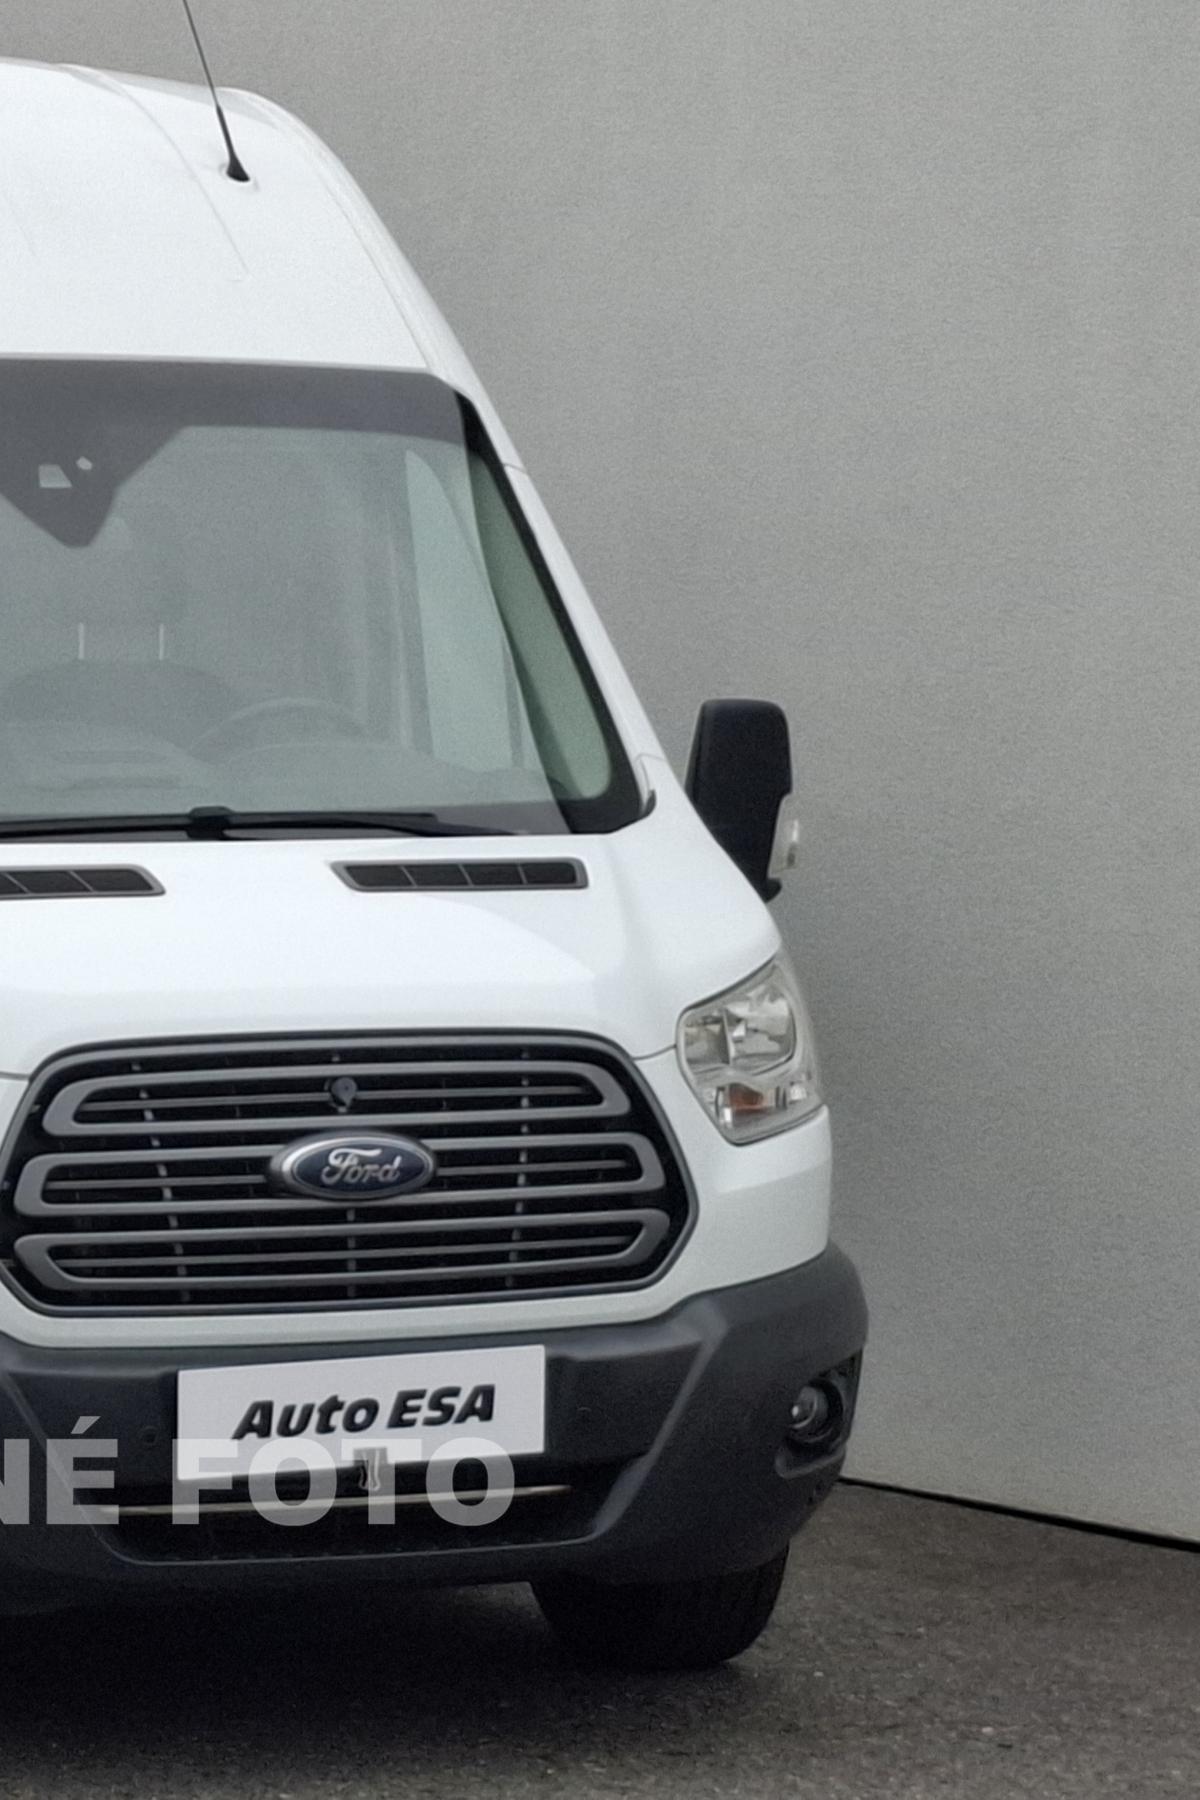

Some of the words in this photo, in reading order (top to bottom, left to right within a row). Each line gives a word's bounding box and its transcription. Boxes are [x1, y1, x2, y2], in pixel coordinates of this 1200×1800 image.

[321, 1148, 402, 1185] Ford
[232, 1395, 379, 1440] Auto
[387, 1384, 496, 1429] ESA
